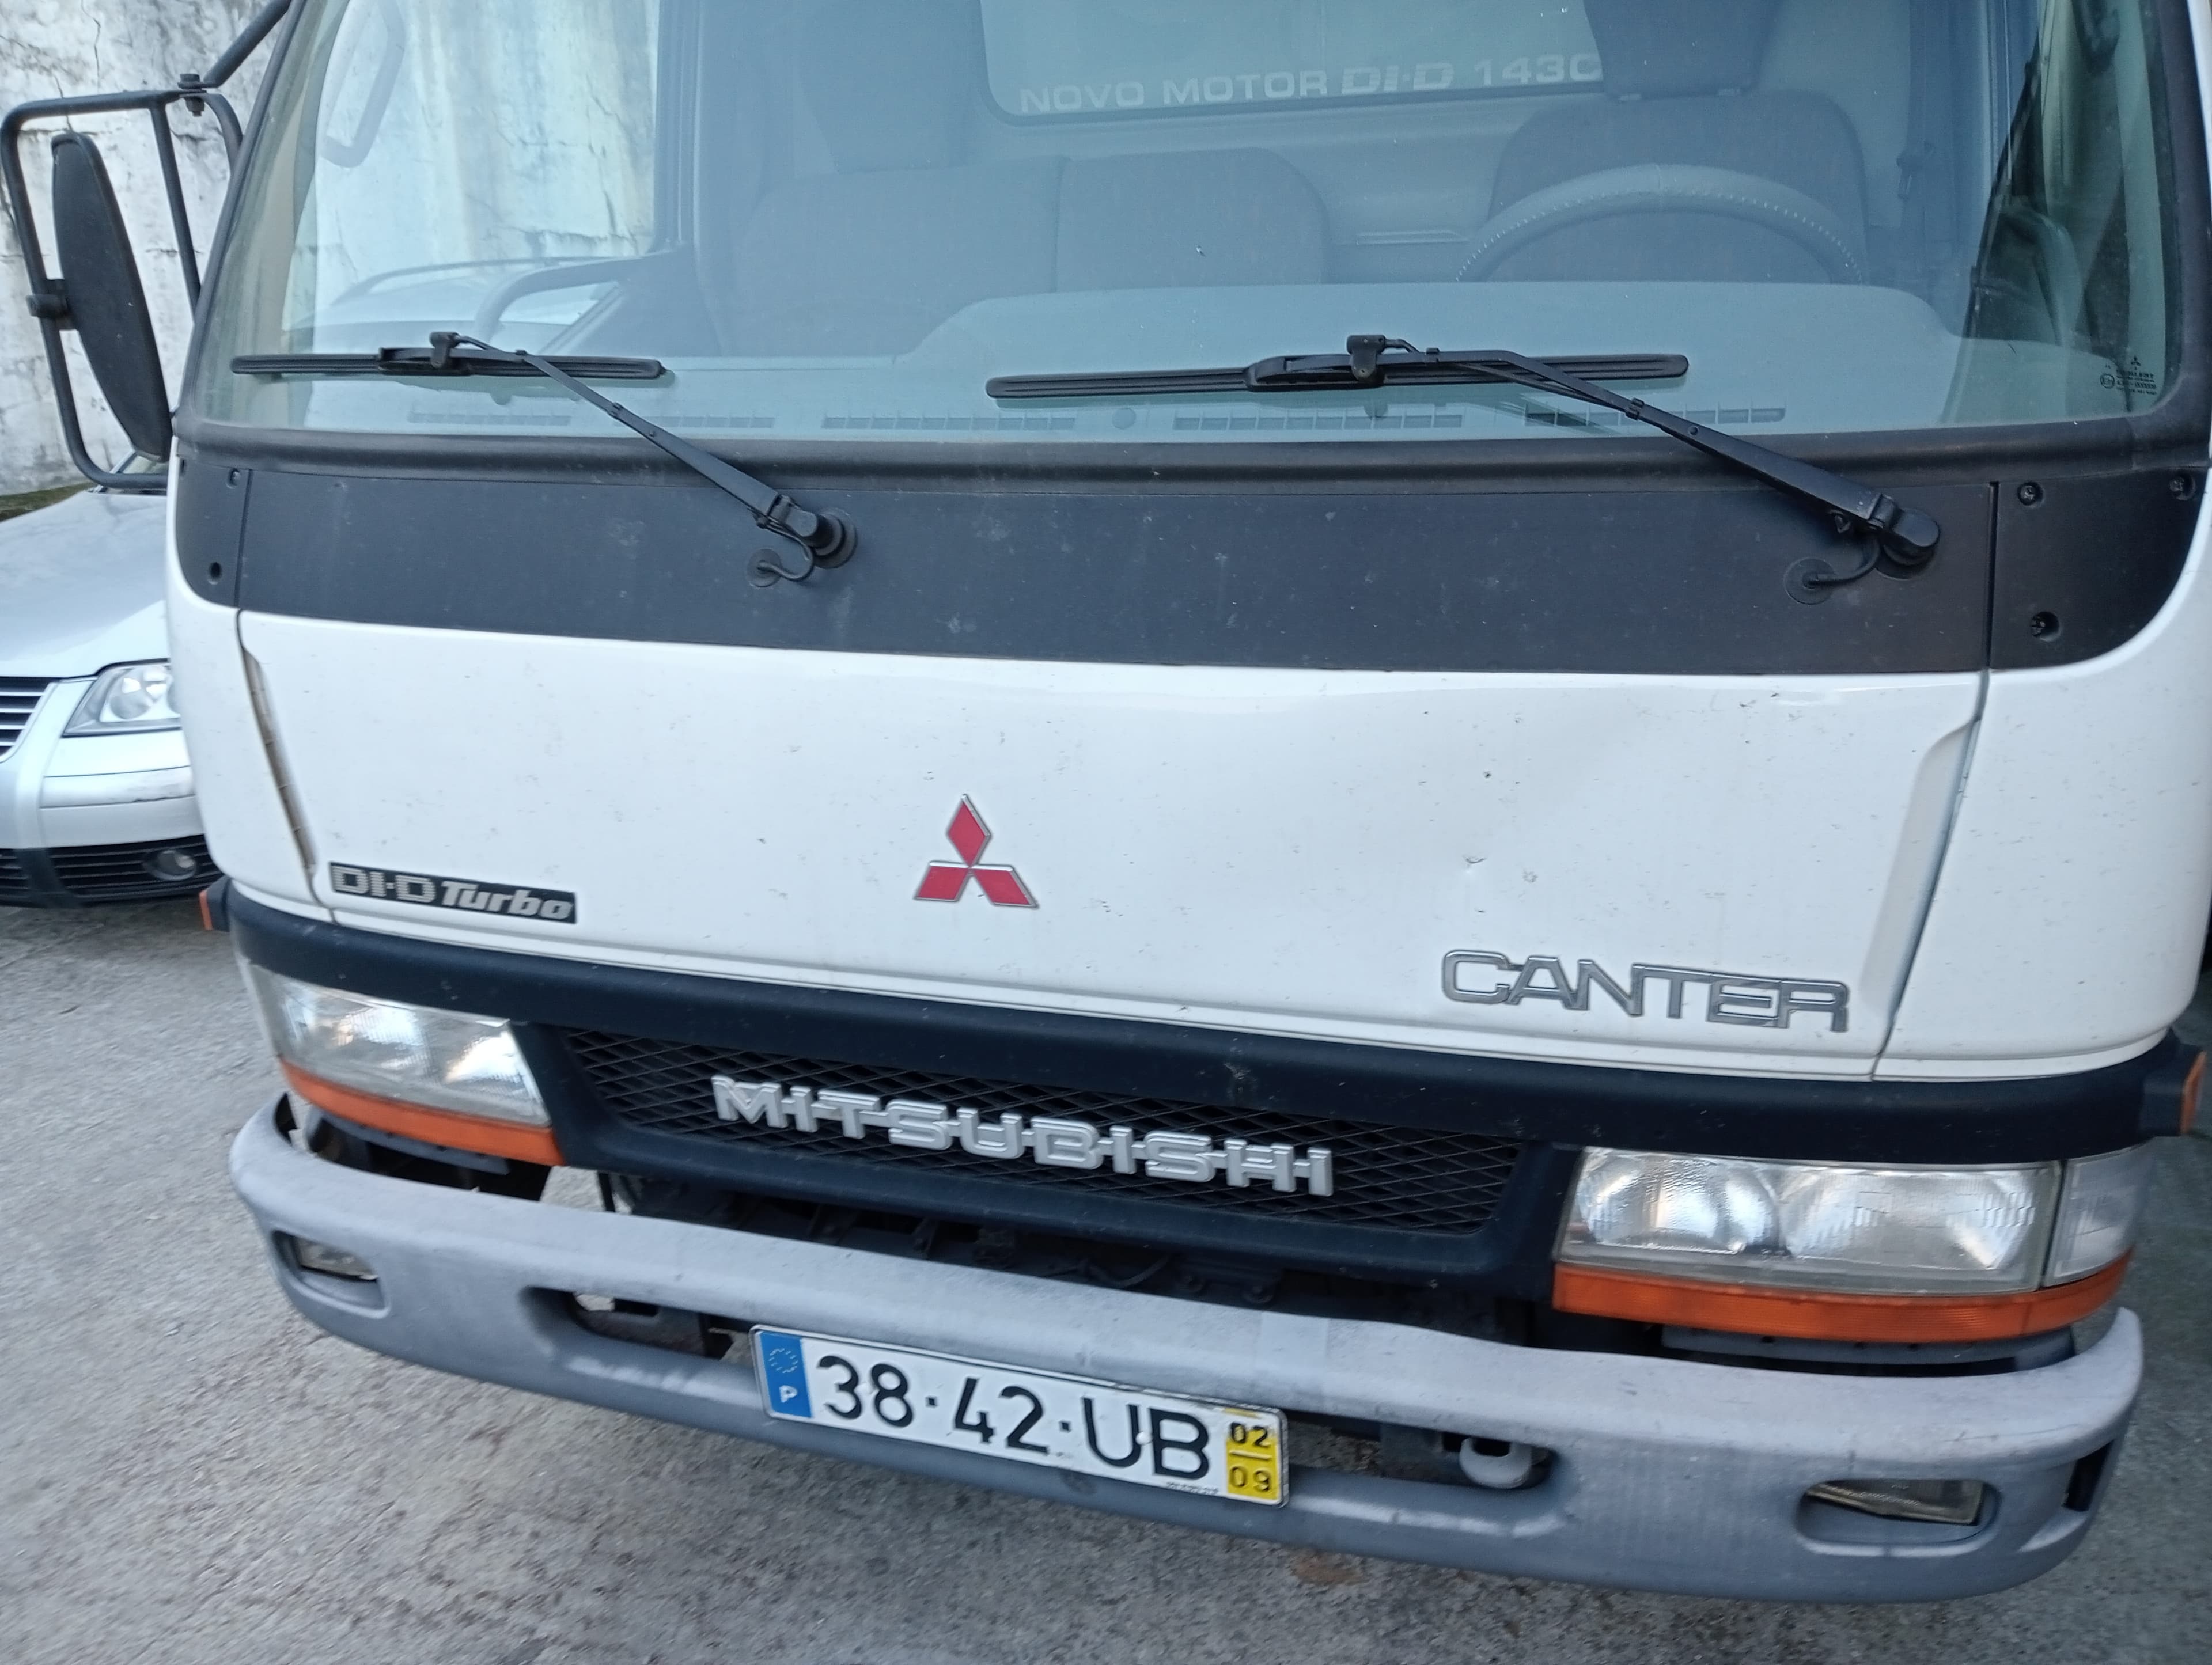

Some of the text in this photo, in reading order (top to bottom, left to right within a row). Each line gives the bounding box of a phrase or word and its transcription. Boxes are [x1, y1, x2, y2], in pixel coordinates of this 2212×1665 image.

[1020, 82, 1145, 113] NOVO
[1163, 70, 1328, 105] MOTOR
[331, 864, 574, 920] DI-D Turbo
[1441, 949, 1849, 1033] CANTER
[710, 1074, 1333, 1197] MITSUBISHI
[779, 1385, 798, 1403] P
[1230, 1421, 1272, 1449] 02
